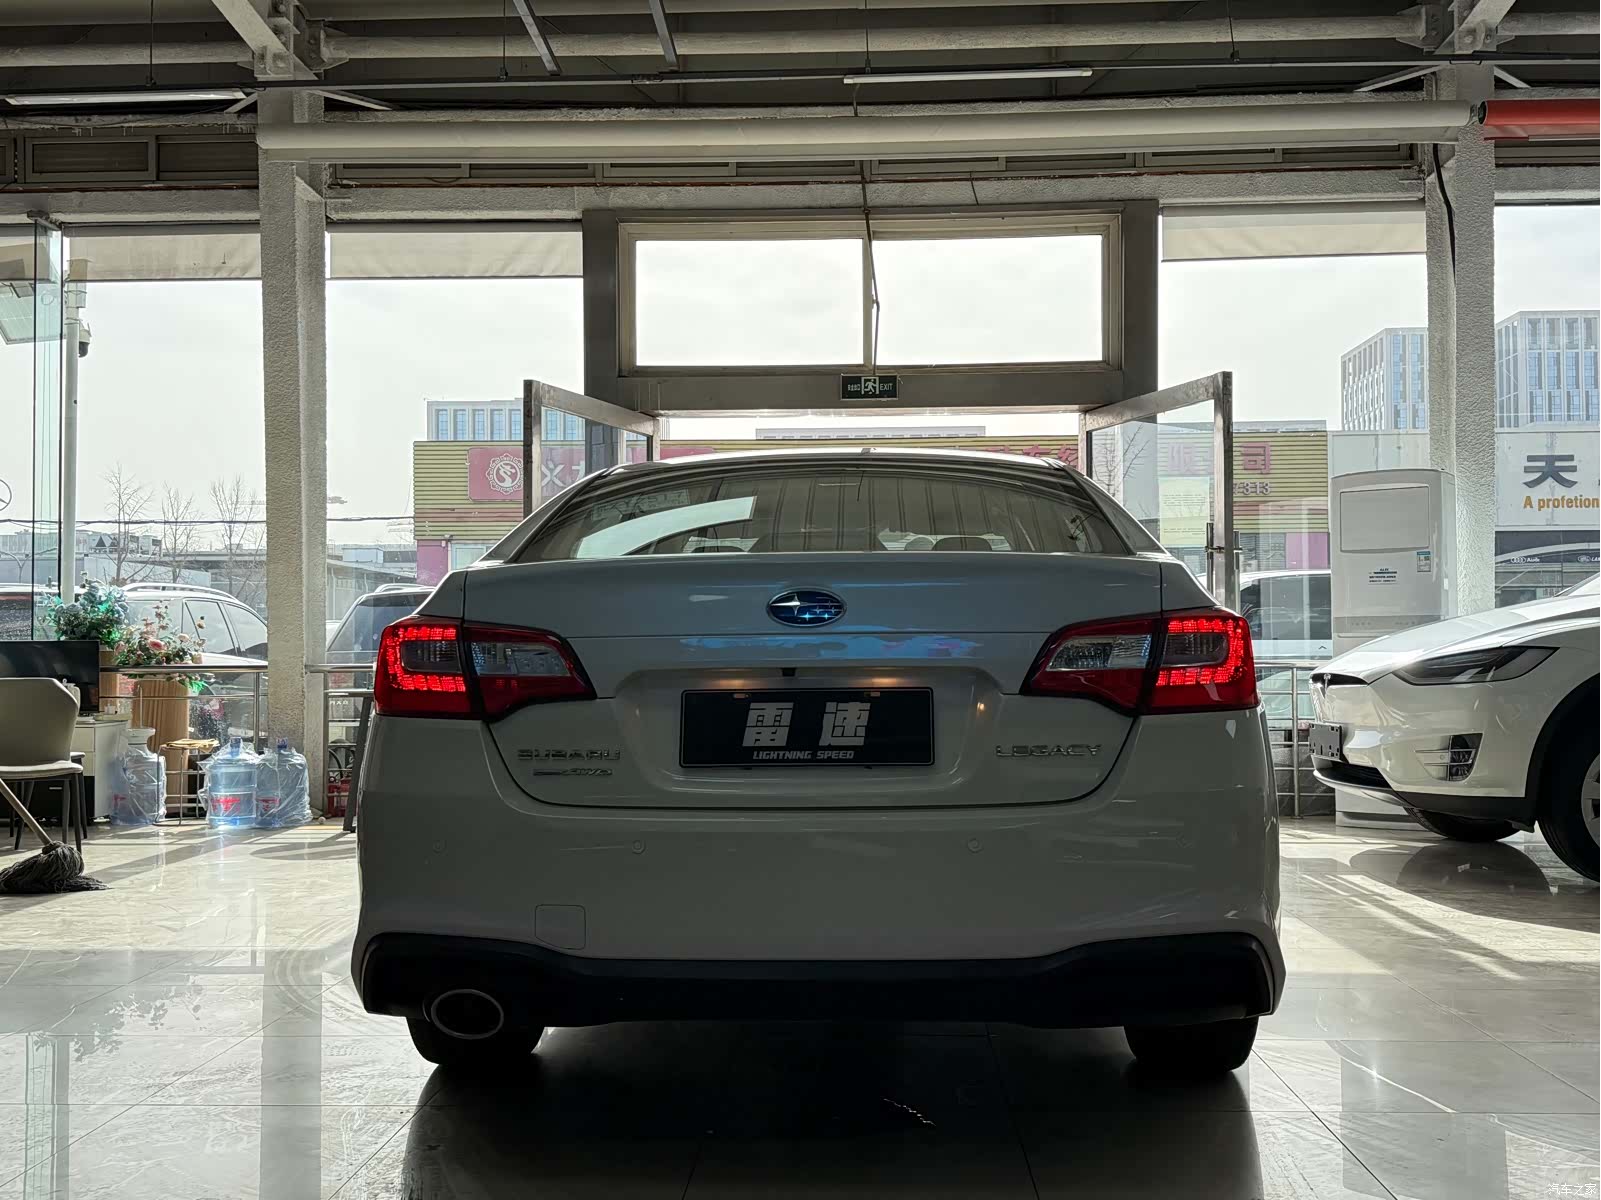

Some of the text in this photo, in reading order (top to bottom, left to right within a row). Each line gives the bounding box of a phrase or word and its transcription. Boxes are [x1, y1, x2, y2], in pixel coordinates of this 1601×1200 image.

[880, 383, 893, 391] EXIT
[1522, 454, 1578, 488] 天
[1523, 495, 1600, 512] A profetion
[742, 701, 872, 747] 雷速
[517, 748, 621, 761] SUBARU
[752, 750, 855, 760] LIGHTNING SPEED
[995, 743, 1102, 757] LEGACY
